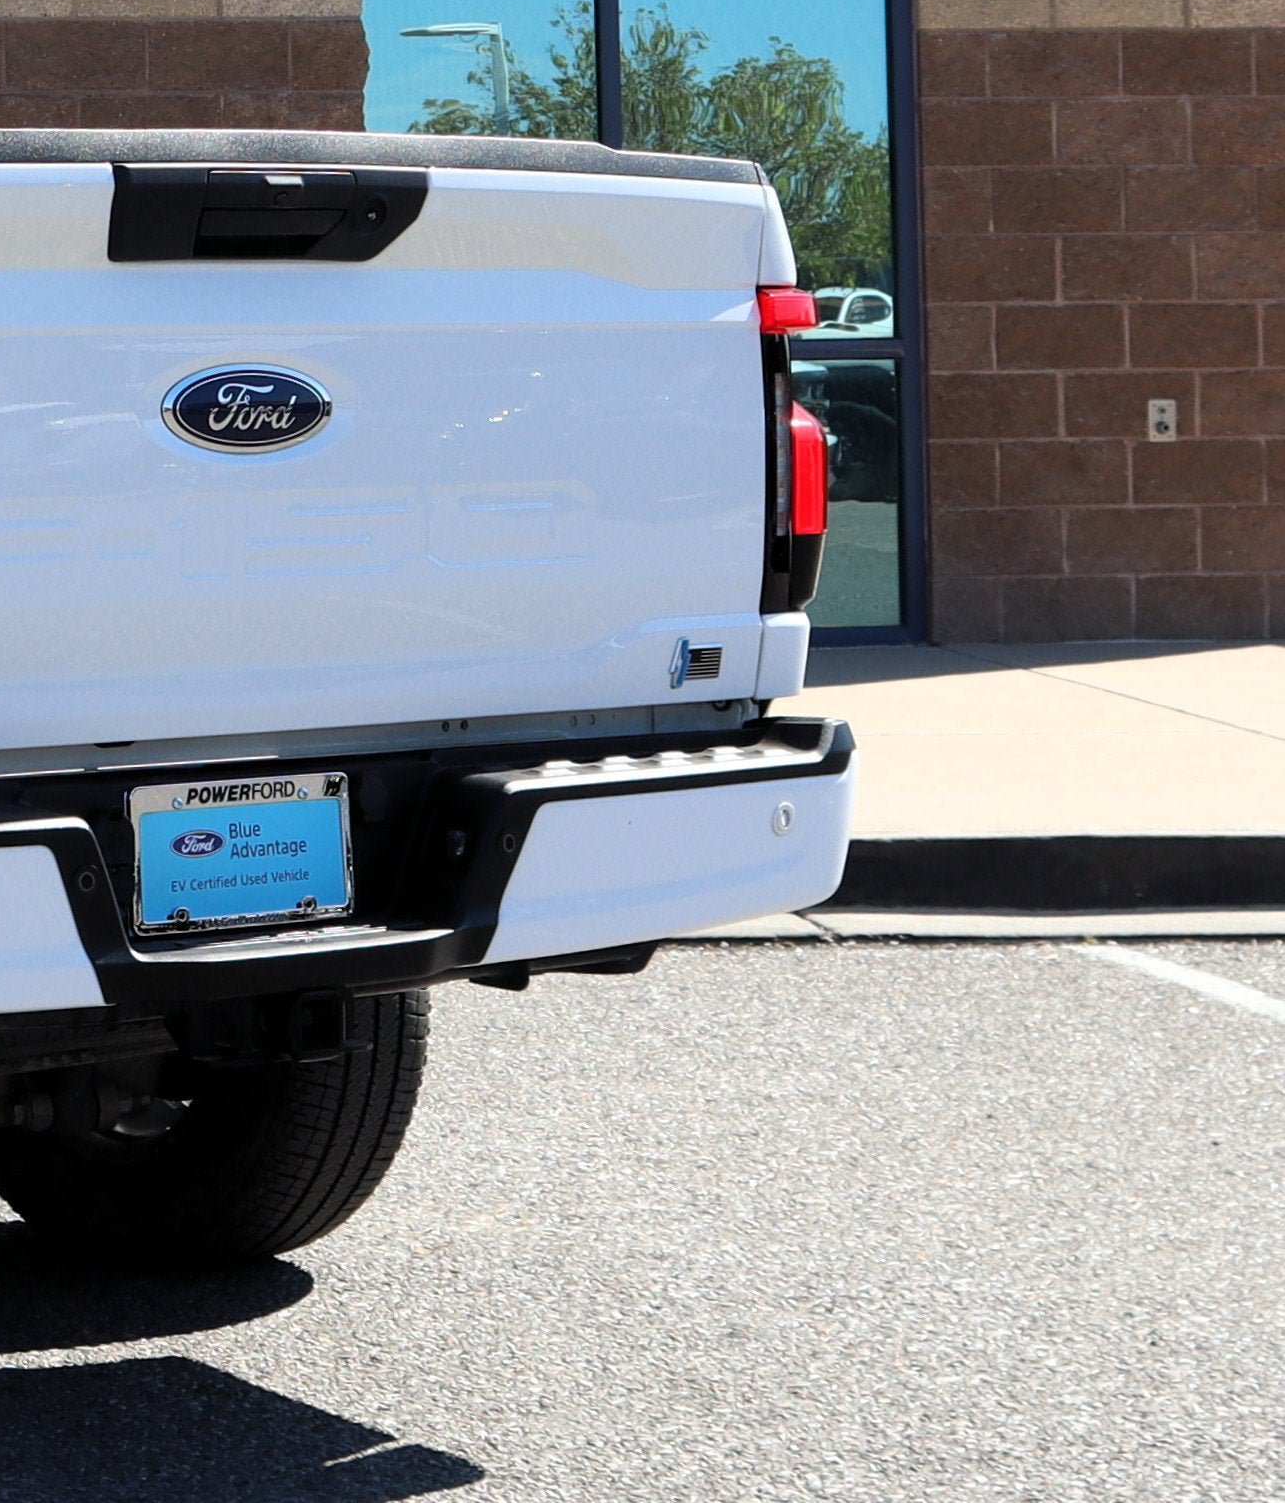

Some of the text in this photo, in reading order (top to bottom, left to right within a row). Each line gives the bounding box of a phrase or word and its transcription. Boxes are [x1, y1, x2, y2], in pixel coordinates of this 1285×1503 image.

[208, 382, 297, 432] Ford
[185, 780, 296, 805] POWERFORD
[228, 821, 261, 839] Blue
[181, 834, 215, 854] Ford
[230, 839, 308, 859] Advantage
[171, 868, 310, 892] EV Certified Used Vehicle
